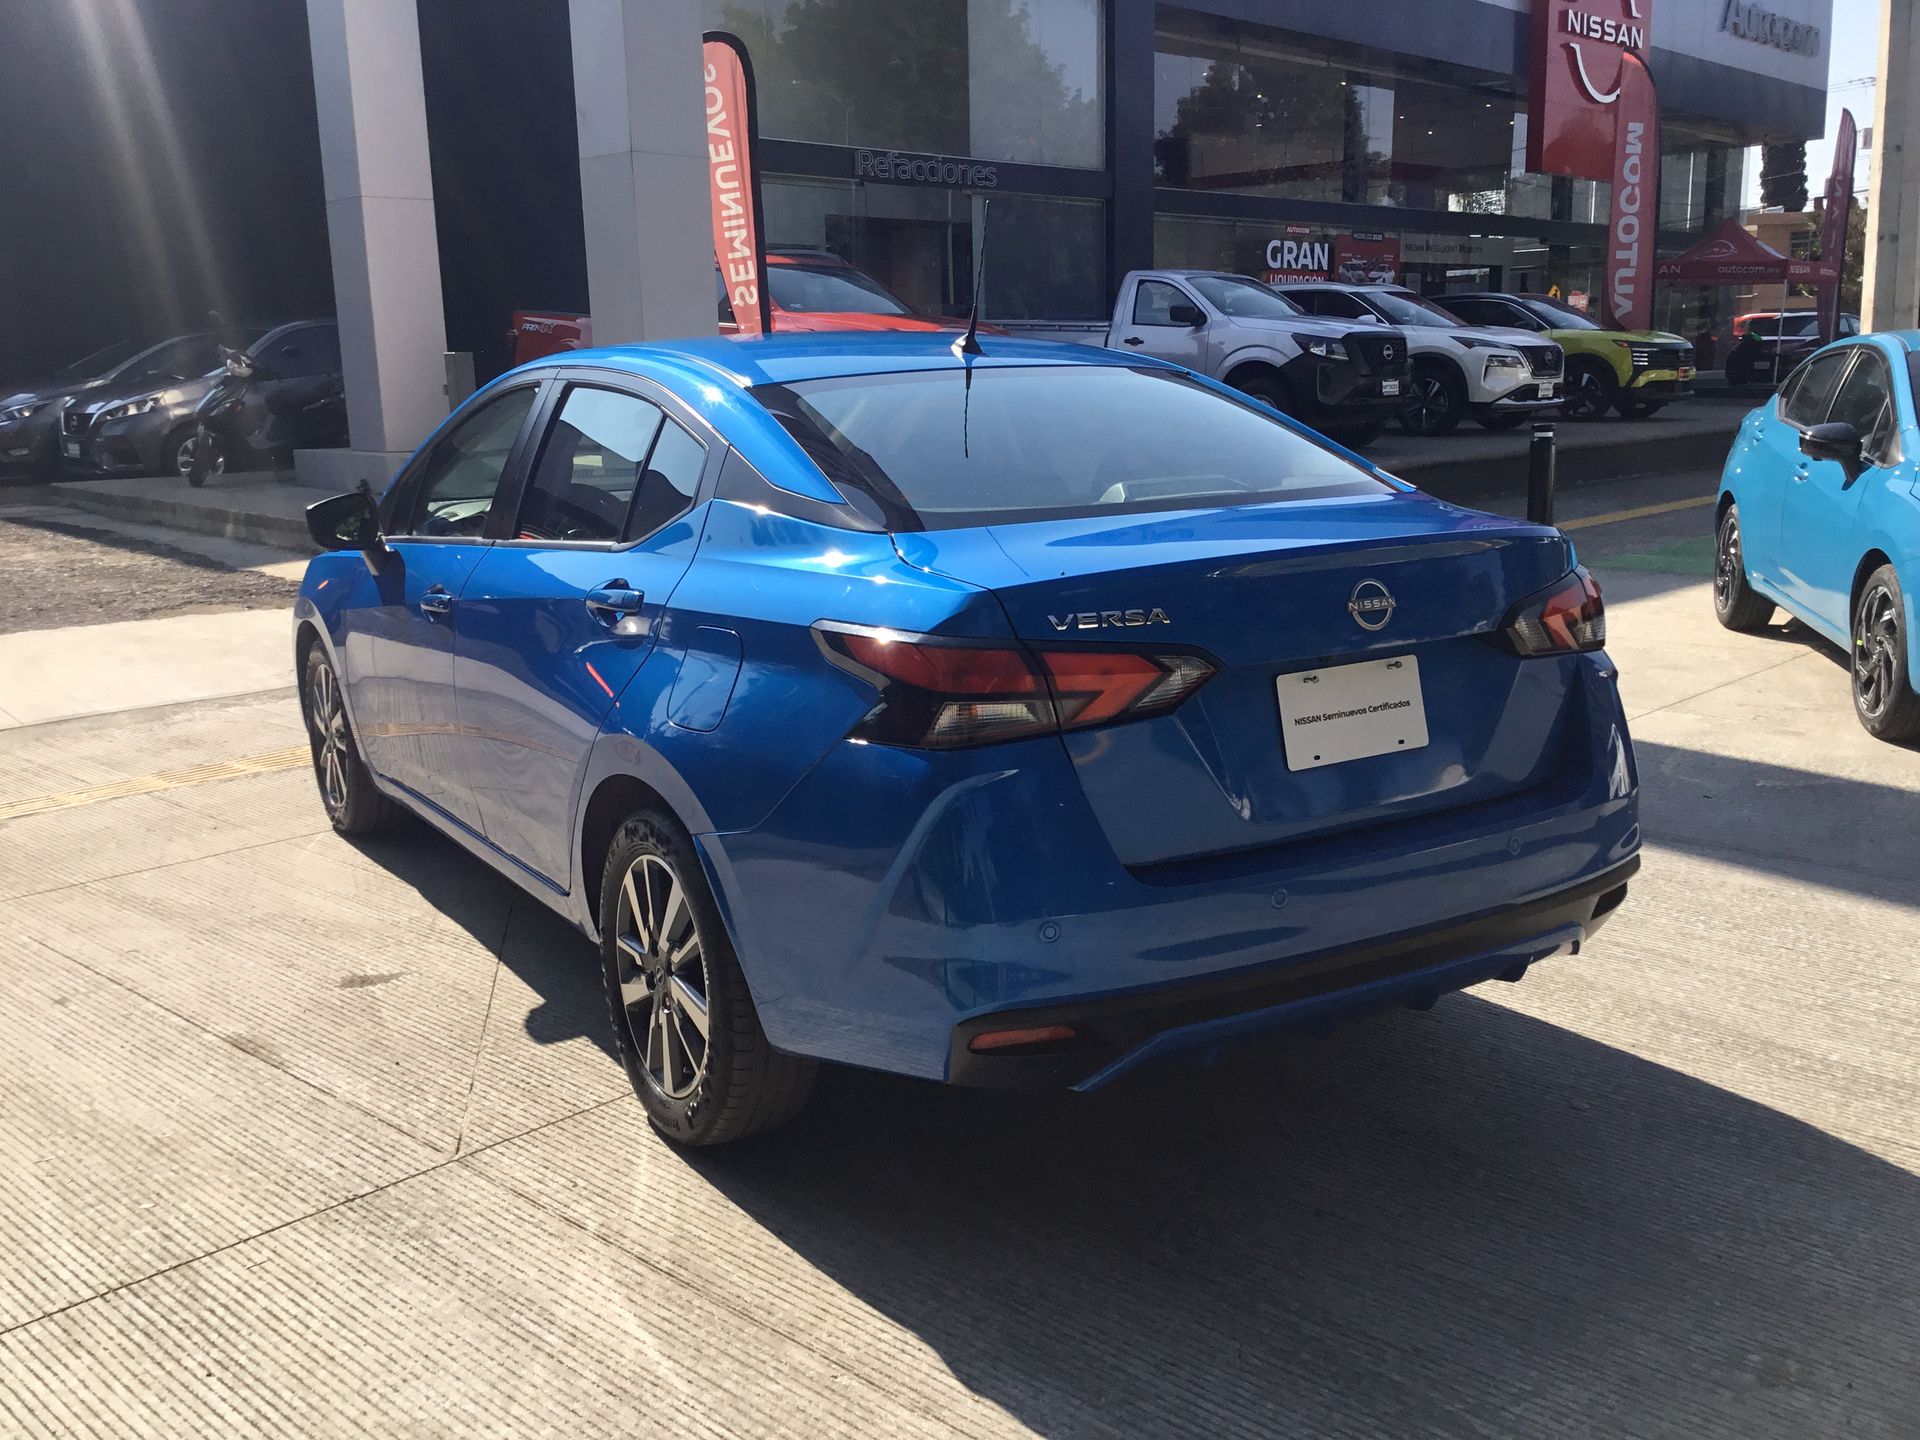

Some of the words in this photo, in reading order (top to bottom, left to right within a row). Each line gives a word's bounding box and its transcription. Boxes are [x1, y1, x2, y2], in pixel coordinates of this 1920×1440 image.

[1567, 9, 1643, 49] NISSAN
[858, 150, 998, 187] Refacciones
[1266, 239, 1329, 271] GRAN
[1348, 598, 1396, 611] NISSAN
[1047, 608, 1171, 631] VERSA
[1294, 714, 1322, 726] NISSAN
[1322, 707, 1367, 721] Seminuevos
[1368, 699, 1411, 713] Certificados
